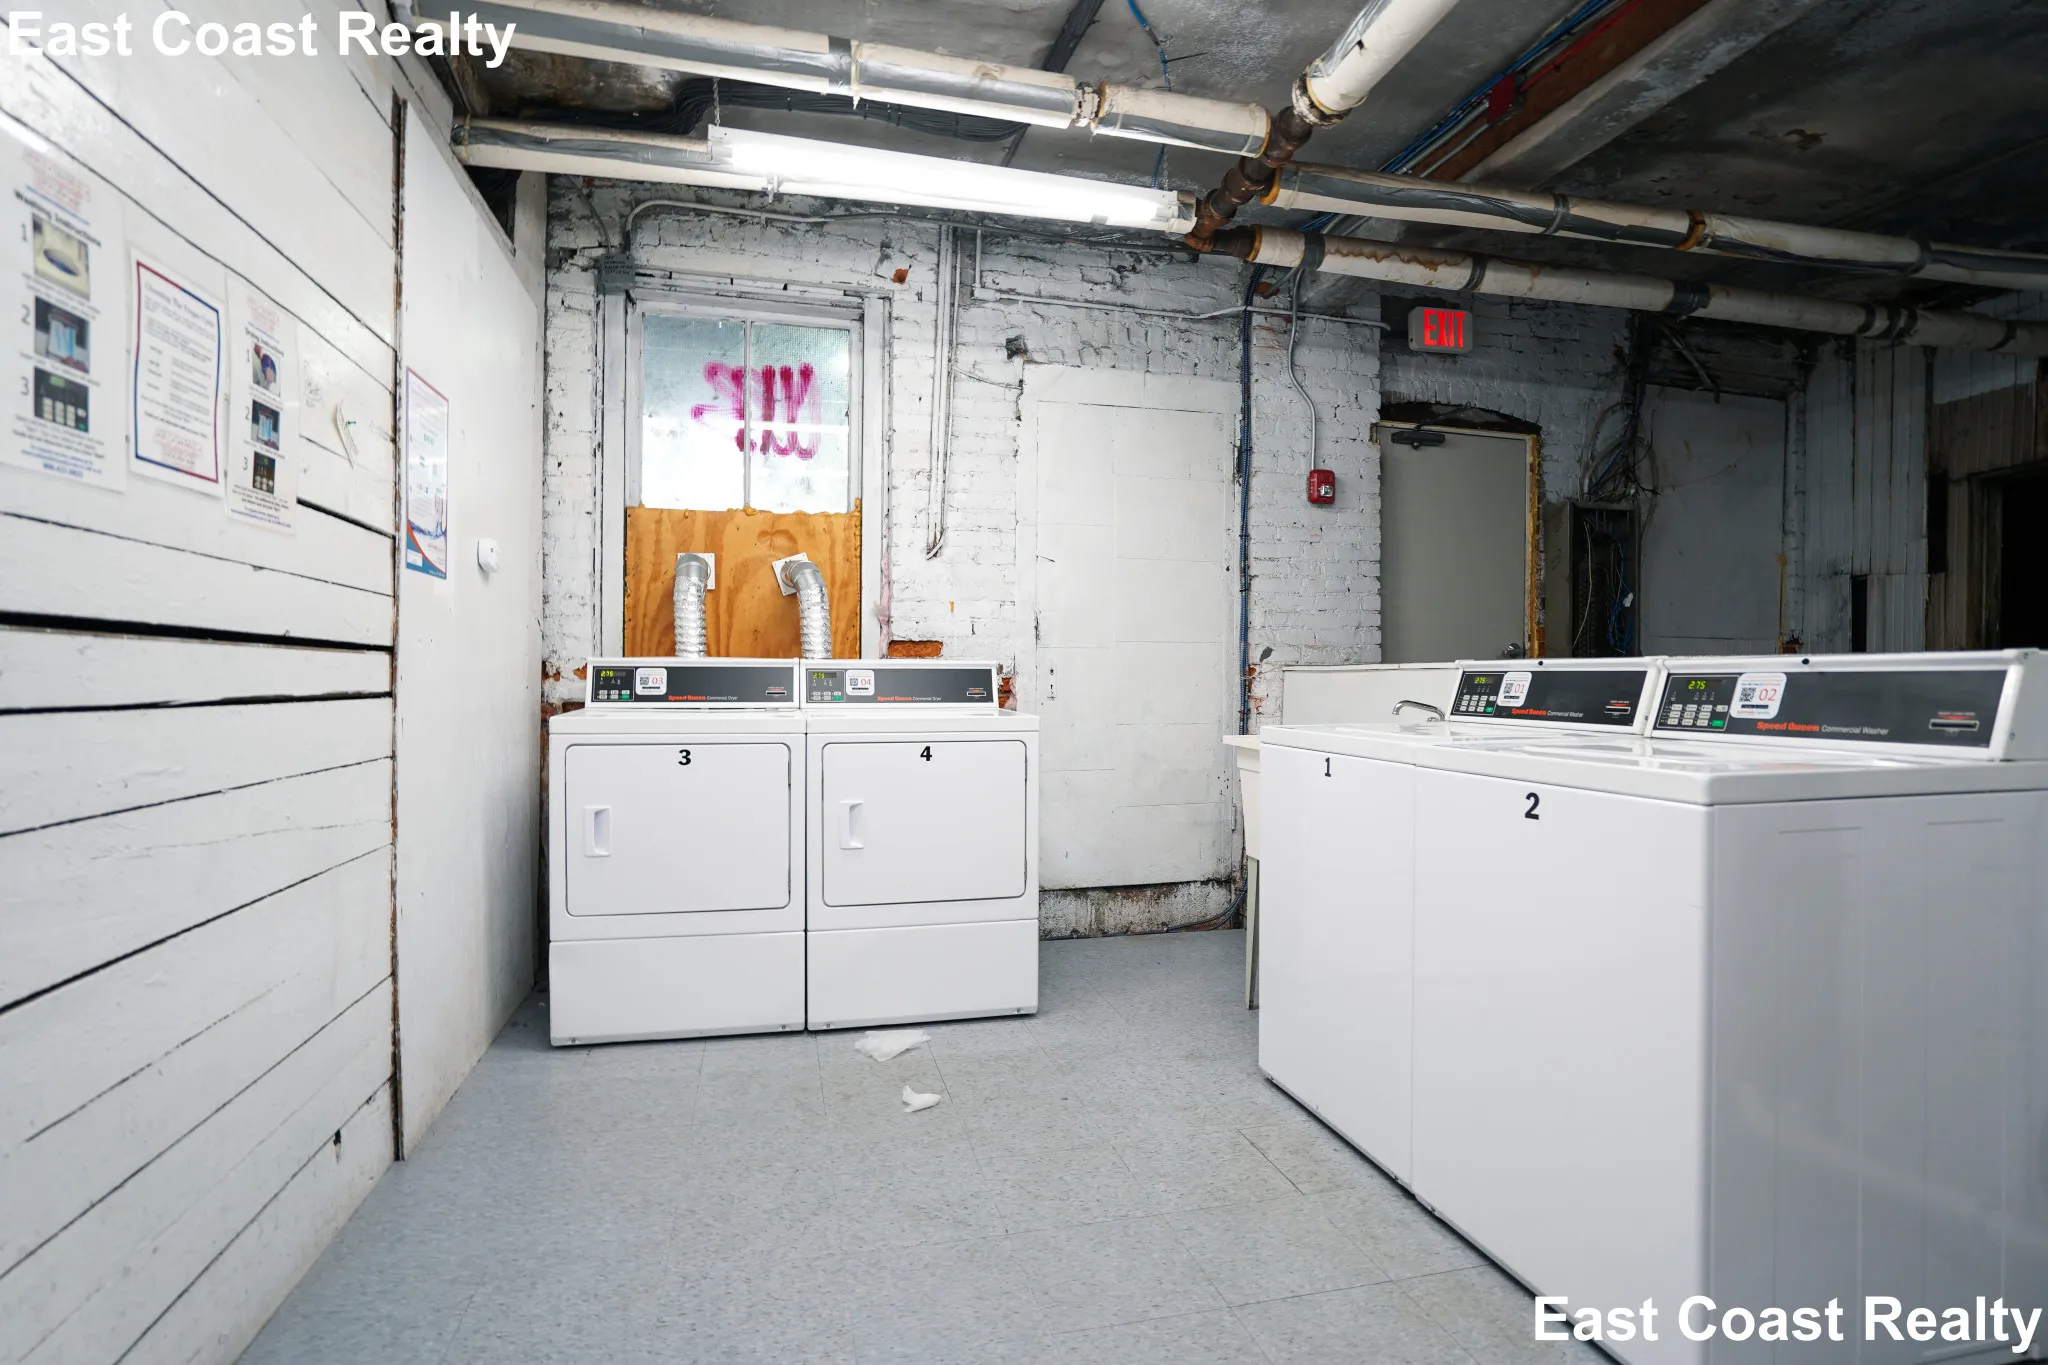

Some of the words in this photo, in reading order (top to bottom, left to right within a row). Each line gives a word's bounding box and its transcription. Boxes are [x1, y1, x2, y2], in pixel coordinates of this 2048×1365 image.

[21, 222, 28, 243] 1
[21, 304, 31, 326] 2
[1423, 309, 1466, 348] EXIT
[20, 376, 30, 396] 3
[651, 676, 664, 685] 03
[860, 678, 872, 686] 04
[1513, 683, 1525, 693] 01
[1758, 688, 1778, 702] 02
[1511, 707, 1529, 715] Speed
[1529, 708, 1547, 716] Queen
[1756, 721, 1787, 731] Speed
[1788, 722, 1820, 732] Queen
[1821, 724, 1861, 734] Commercial
[1862, 726, 1889, 735] Washer
[678, 749, 692, 766] 3
[920, 746, 933, 762] 4
[1324, 757, 1332, 778] 1
[1524, 792, 1540, 820] 2
